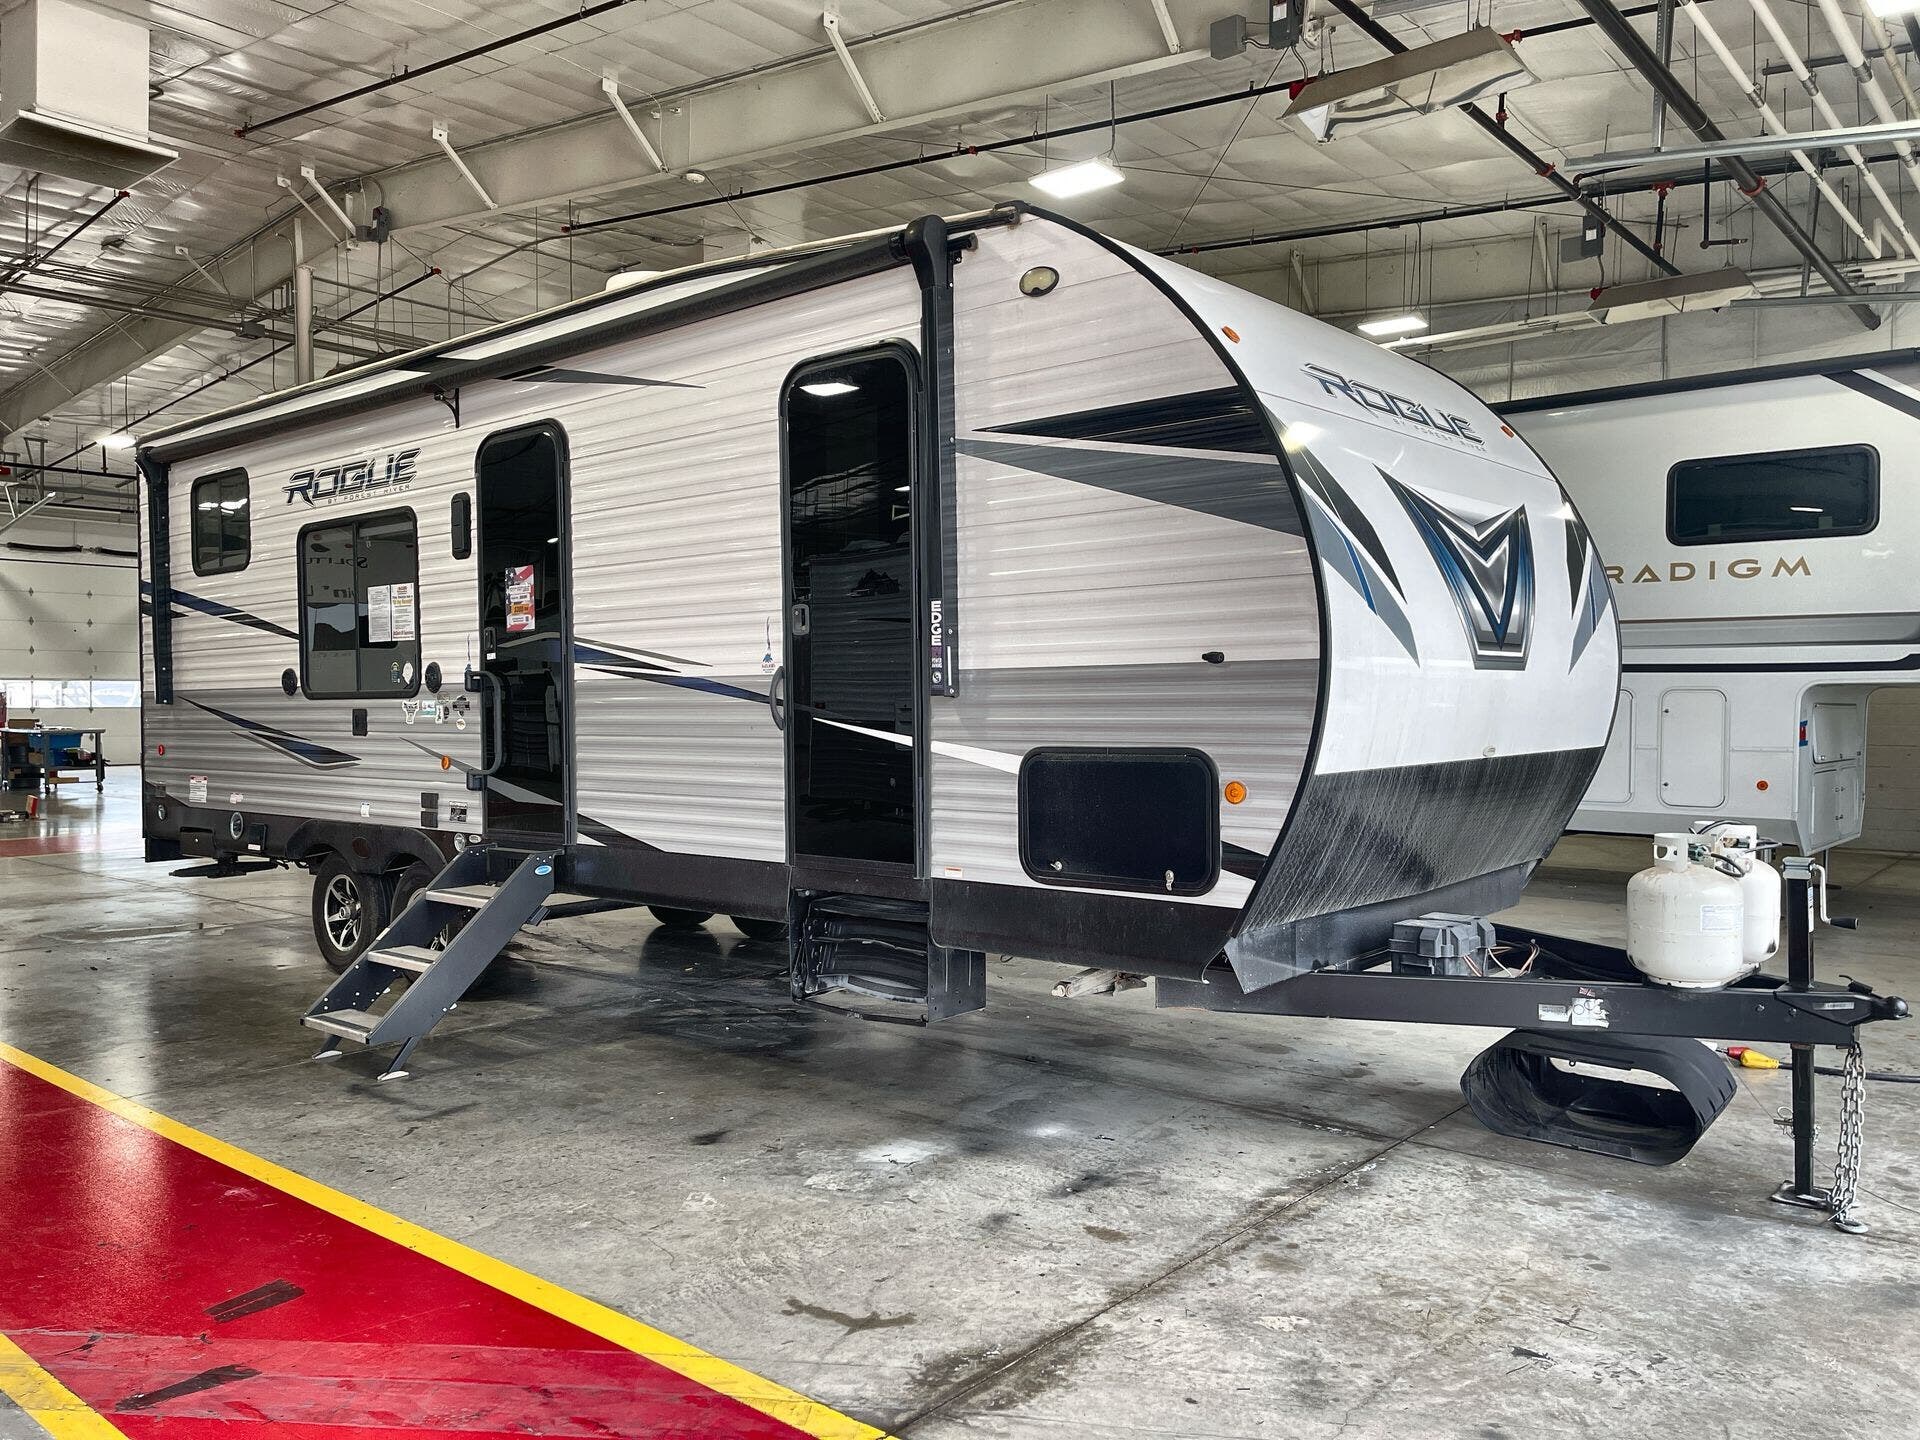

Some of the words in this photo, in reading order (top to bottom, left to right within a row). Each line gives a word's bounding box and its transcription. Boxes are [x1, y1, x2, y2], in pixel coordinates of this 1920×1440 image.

[1300, 363, 1485, 446] ROGUE
[282, 448, 421, 507] ROGUE
[327, 497, 337, 505] BY
[343, 491, 377, 501] FOREST
[383, 484, 411, 494] RIVER
[930, 600, 942, 646] EDGE
